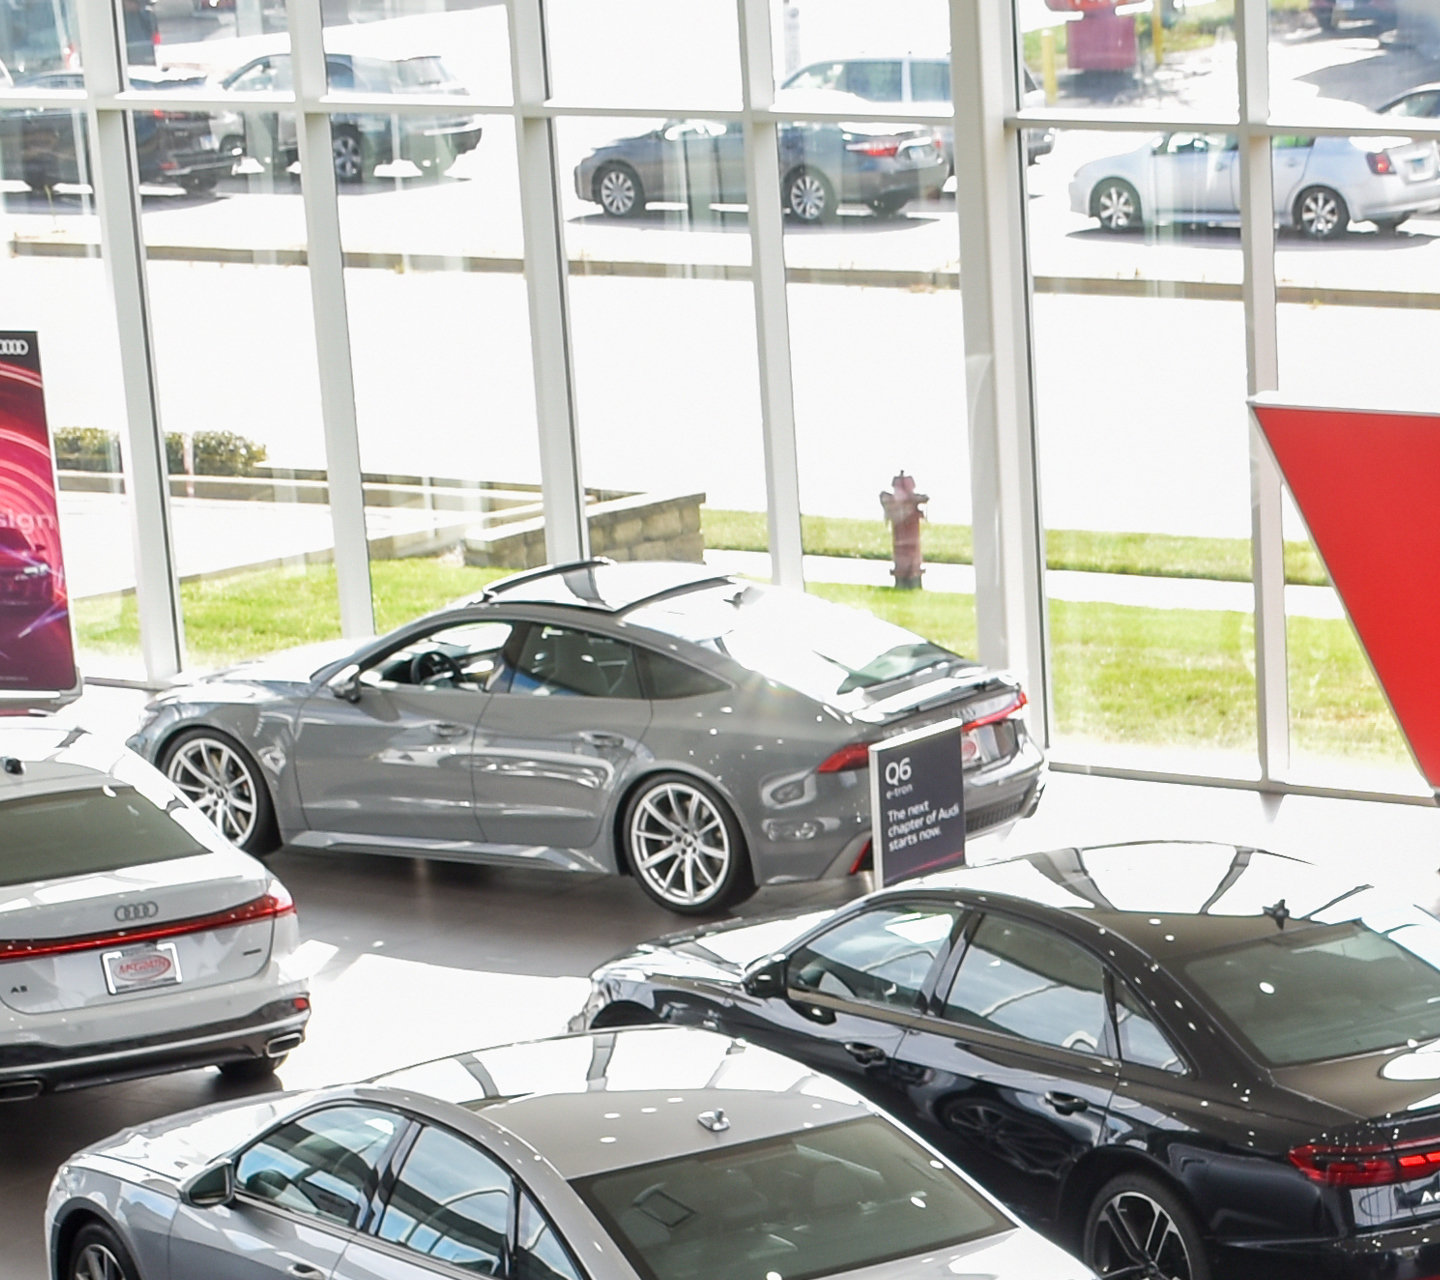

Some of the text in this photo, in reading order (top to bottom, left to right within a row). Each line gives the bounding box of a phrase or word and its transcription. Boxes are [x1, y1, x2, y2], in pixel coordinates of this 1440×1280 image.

[885, 757, 912, 786] Q6
[887, 800, 929, 822] The next
[888, 803, 959, 838] chapter of Audi
[888, 833, 918, 852] starts
